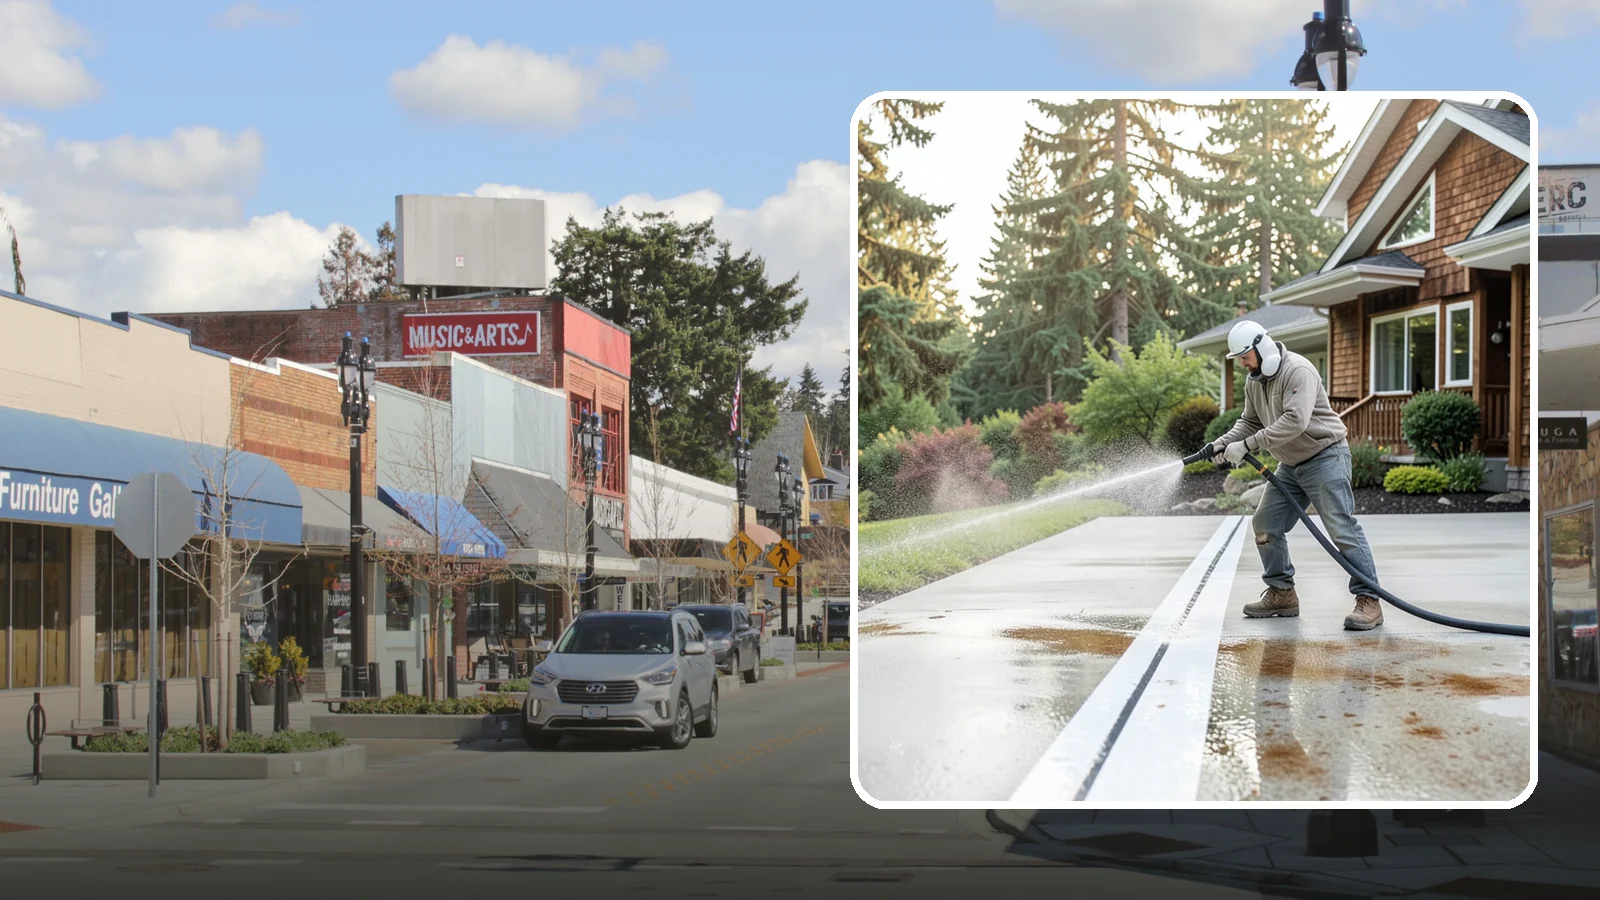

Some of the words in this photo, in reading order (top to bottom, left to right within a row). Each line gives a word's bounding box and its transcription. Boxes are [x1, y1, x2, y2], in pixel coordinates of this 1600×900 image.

[409, 323, 520, 349] MUSIC&ARTS
[0, 471, 79, 515] Furniture
[89, 482, 122, 519] Gal
